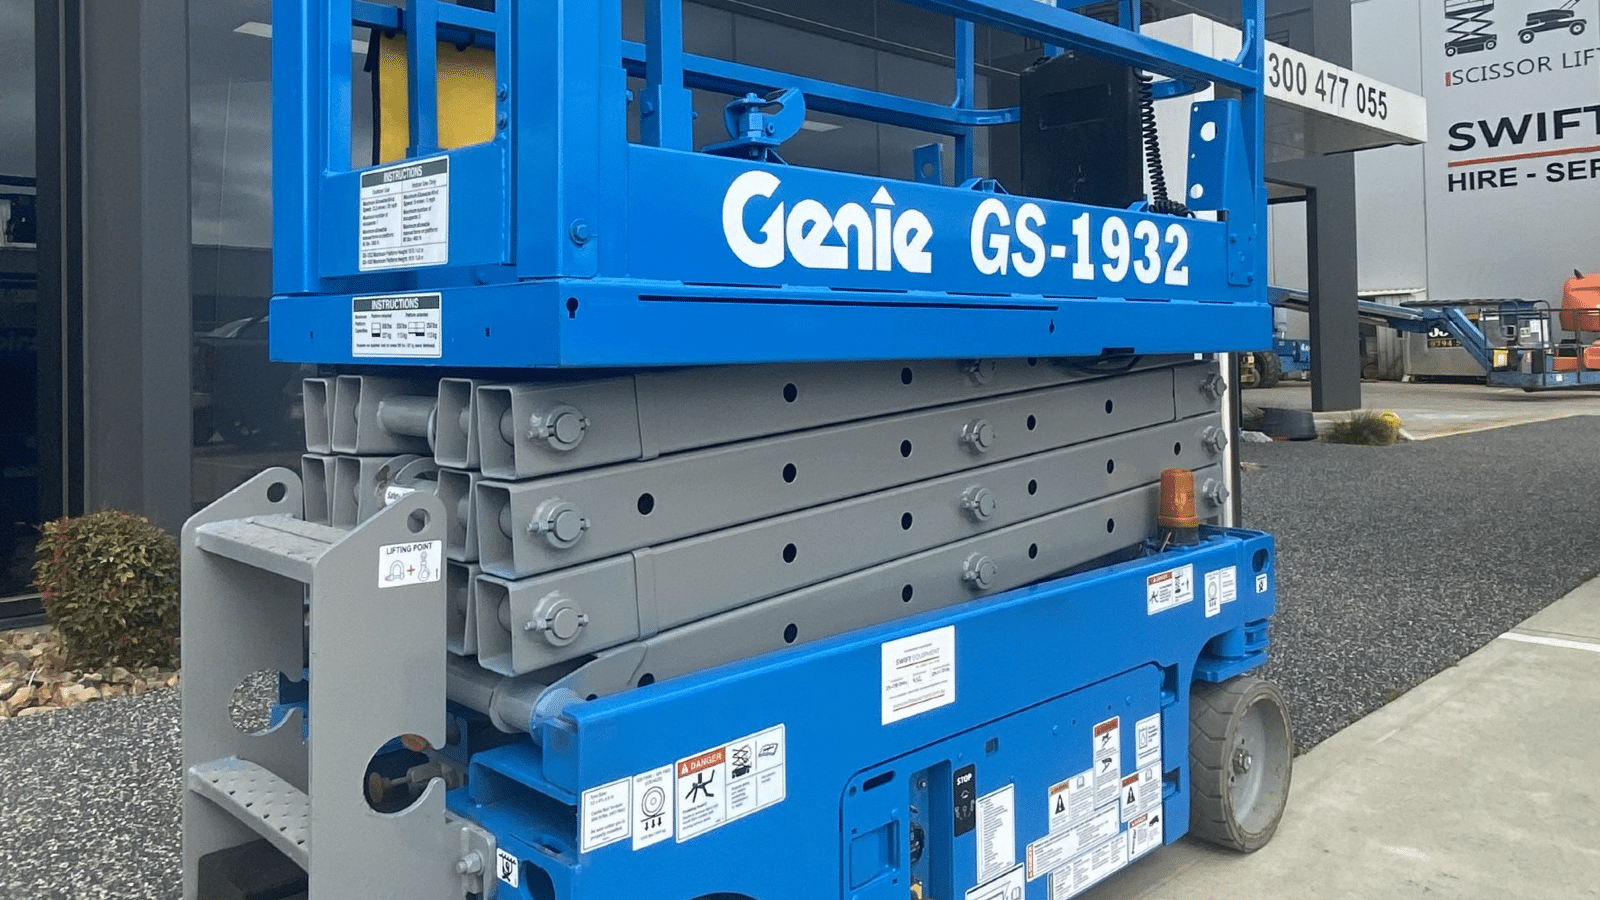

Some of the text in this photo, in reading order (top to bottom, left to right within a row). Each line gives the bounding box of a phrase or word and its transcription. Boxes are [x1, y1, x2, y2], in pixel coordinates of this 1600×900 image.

[1452, 56, 1552, 86] SCISSOR
[1269, 53, 1387, 120] 300 477 055
[383, 166, 423, 182] INSTRUCTIONS
[1448, 167, 1518, 192] HIRE
[722, 170, 1189, 286] Genie GS-1932
[371, 298, 419, 310] INSTRUCTIONS
[386, 542, 433, 555] LIFTING POINT
[896, 655, 912, 666] SWIFT
[690, 752, 722, 771] DANGER
[956, 773, 973, 786] STOP
